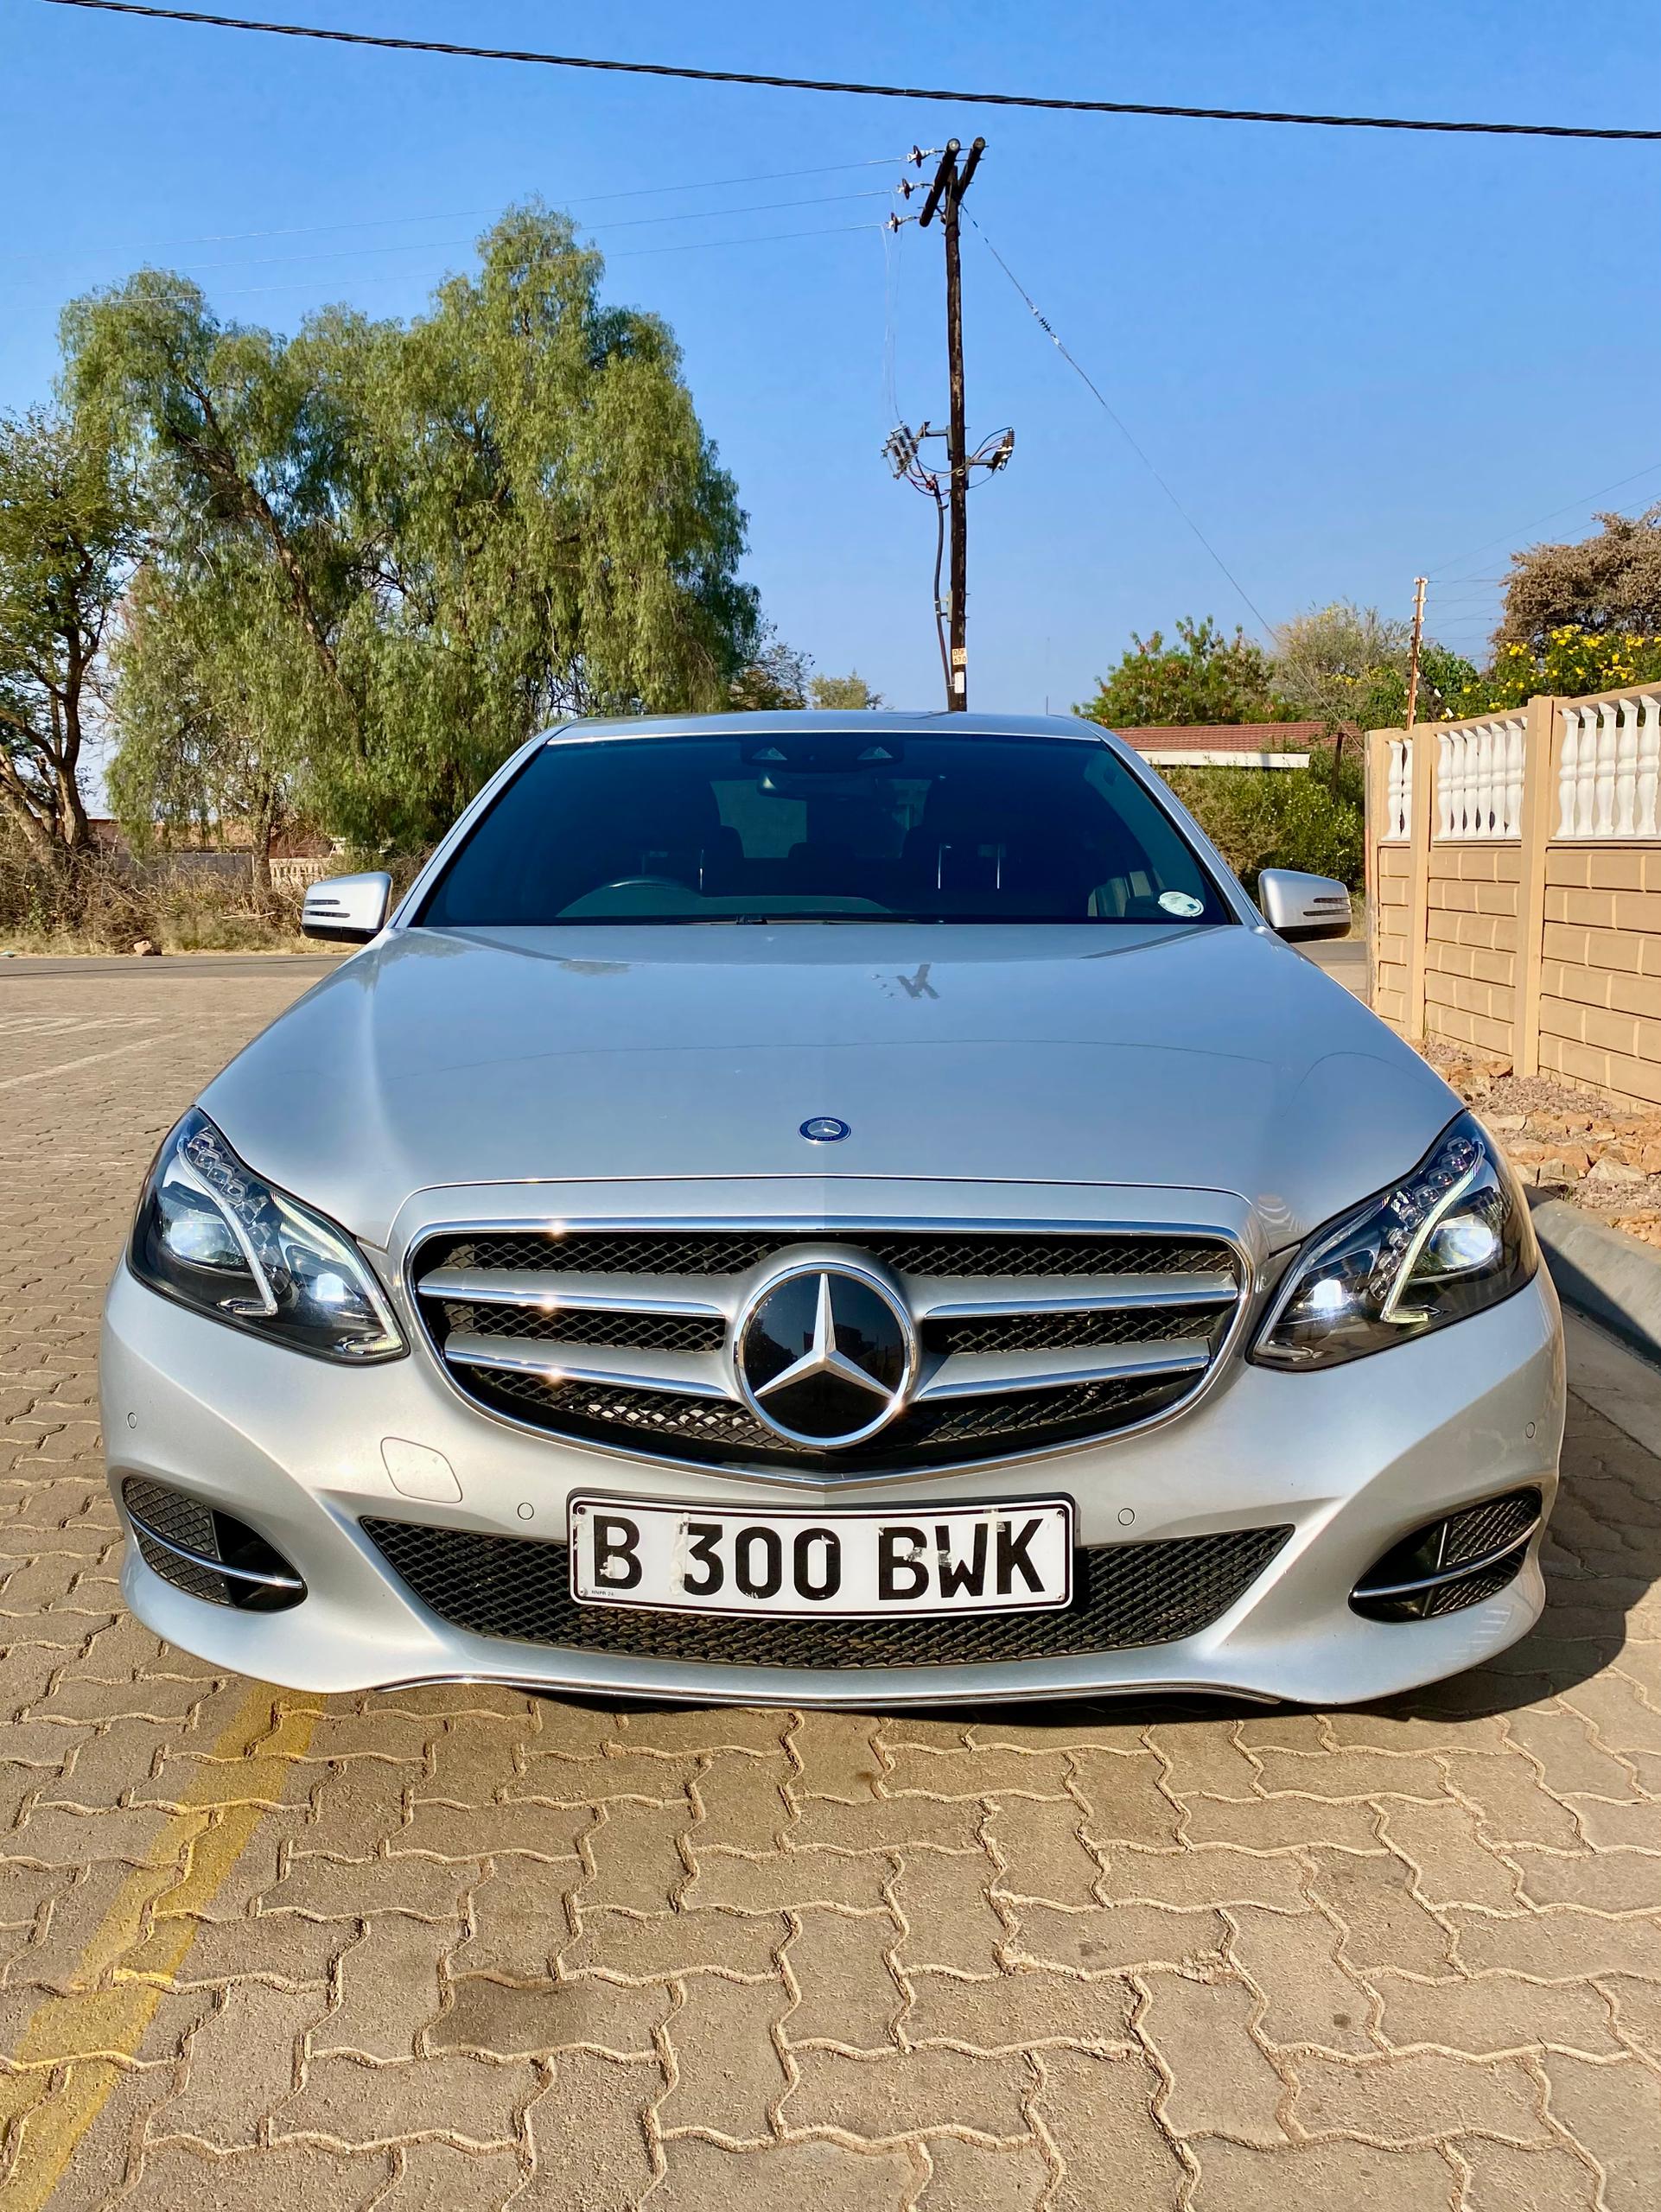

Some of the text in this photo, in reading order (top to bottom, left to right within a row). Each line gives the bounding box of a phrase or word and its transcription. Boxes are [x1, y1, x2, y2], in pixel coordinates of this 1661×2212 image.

[594, 1515, 1045, 1601] B 300 BWK
